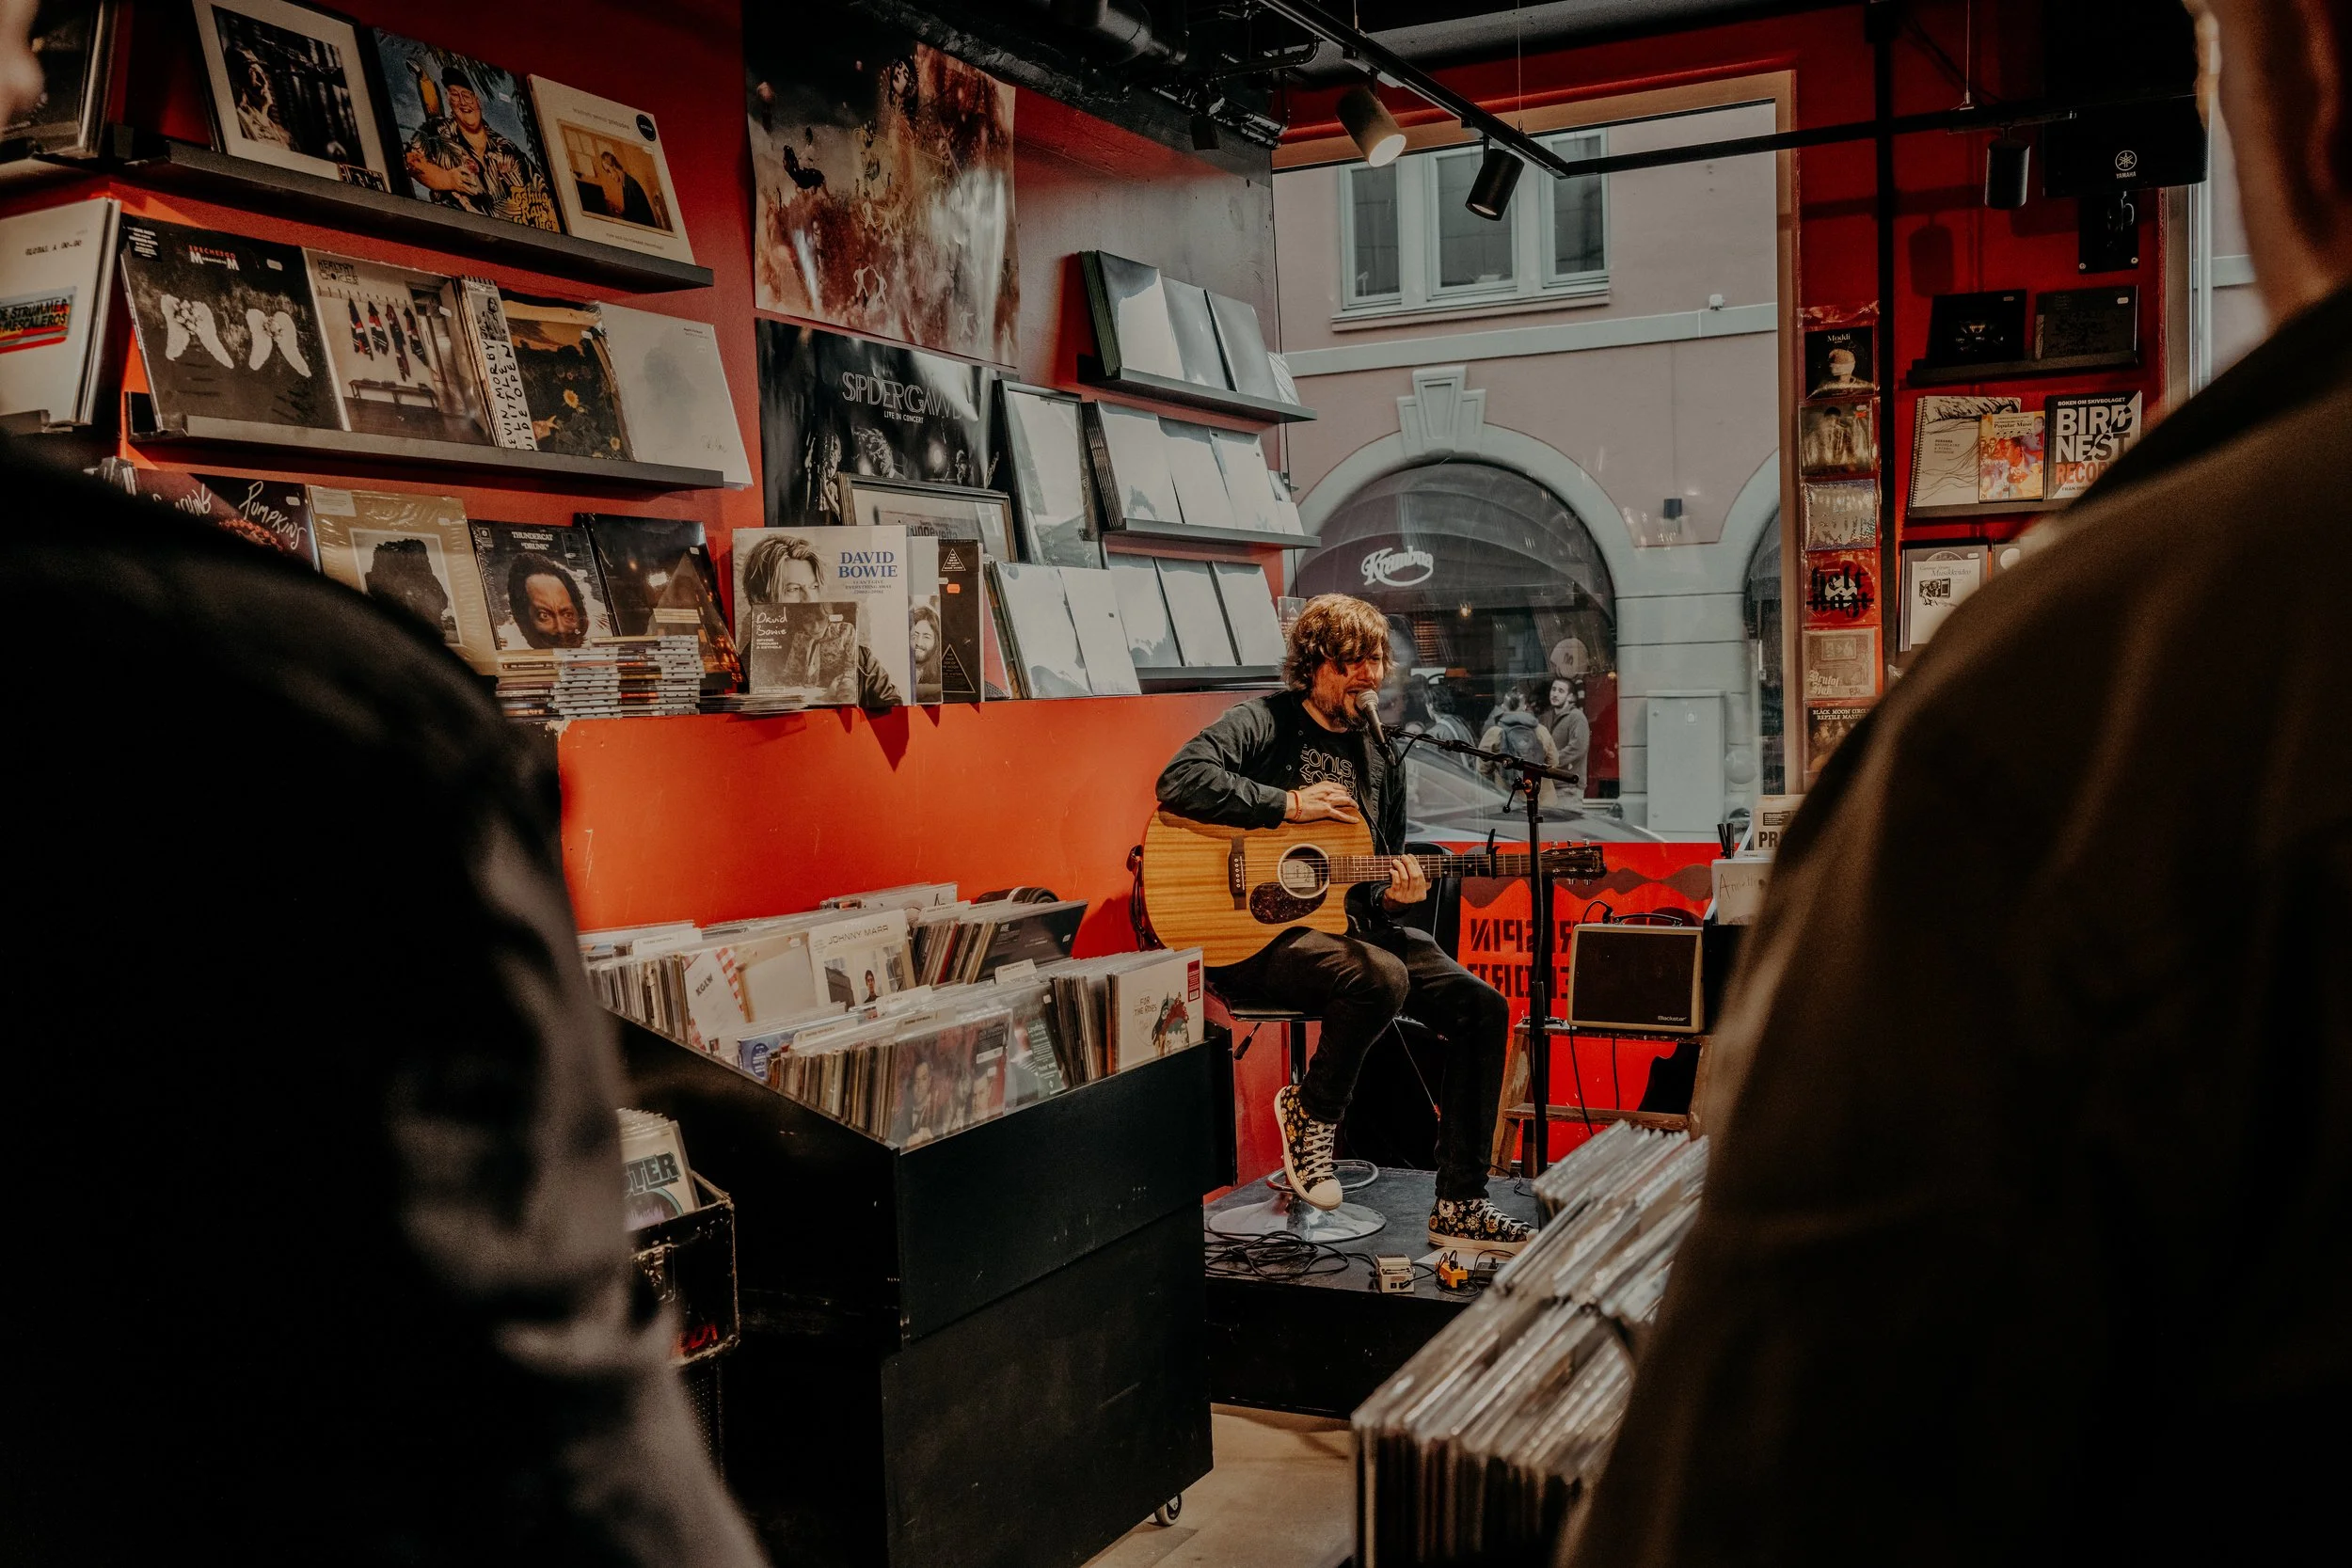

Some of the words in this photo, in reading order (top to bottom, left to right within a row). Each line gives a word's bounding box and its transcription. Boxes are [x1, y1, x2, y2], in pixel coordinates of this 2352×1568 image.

[317, 259, 355, 276] HEALTHY
[11, 299, 68, 319] STRUMMER
[2, 314, 67, 333] MESCALEROS
[483, 341, 505, 400] MORBY
[501, 344, 523, 398] OPEN
[500, 365, 522, 431] LITTLE
[884, 410, 895, 420] LIVE
[903, 414, 924, 424] CONCERT
[2057, 404, 2133, 436] BIRD
[2056, 433, 2130, 463] NEST
[2056, 461, 2108, 484] RECOR
[511, 531, 553, 541] THUNDERCAT
[840, 551, 895, 564] DAVID
[838, 565, 898, 578] BOWIE
[756, 606, 787, 624] David
[756, 625, 787, 636] Bowie
[828, 930, 862, 944] JOHNNY
[864, 925, 889, 936] MARR
[695, 973, 713, 996] KGLW
